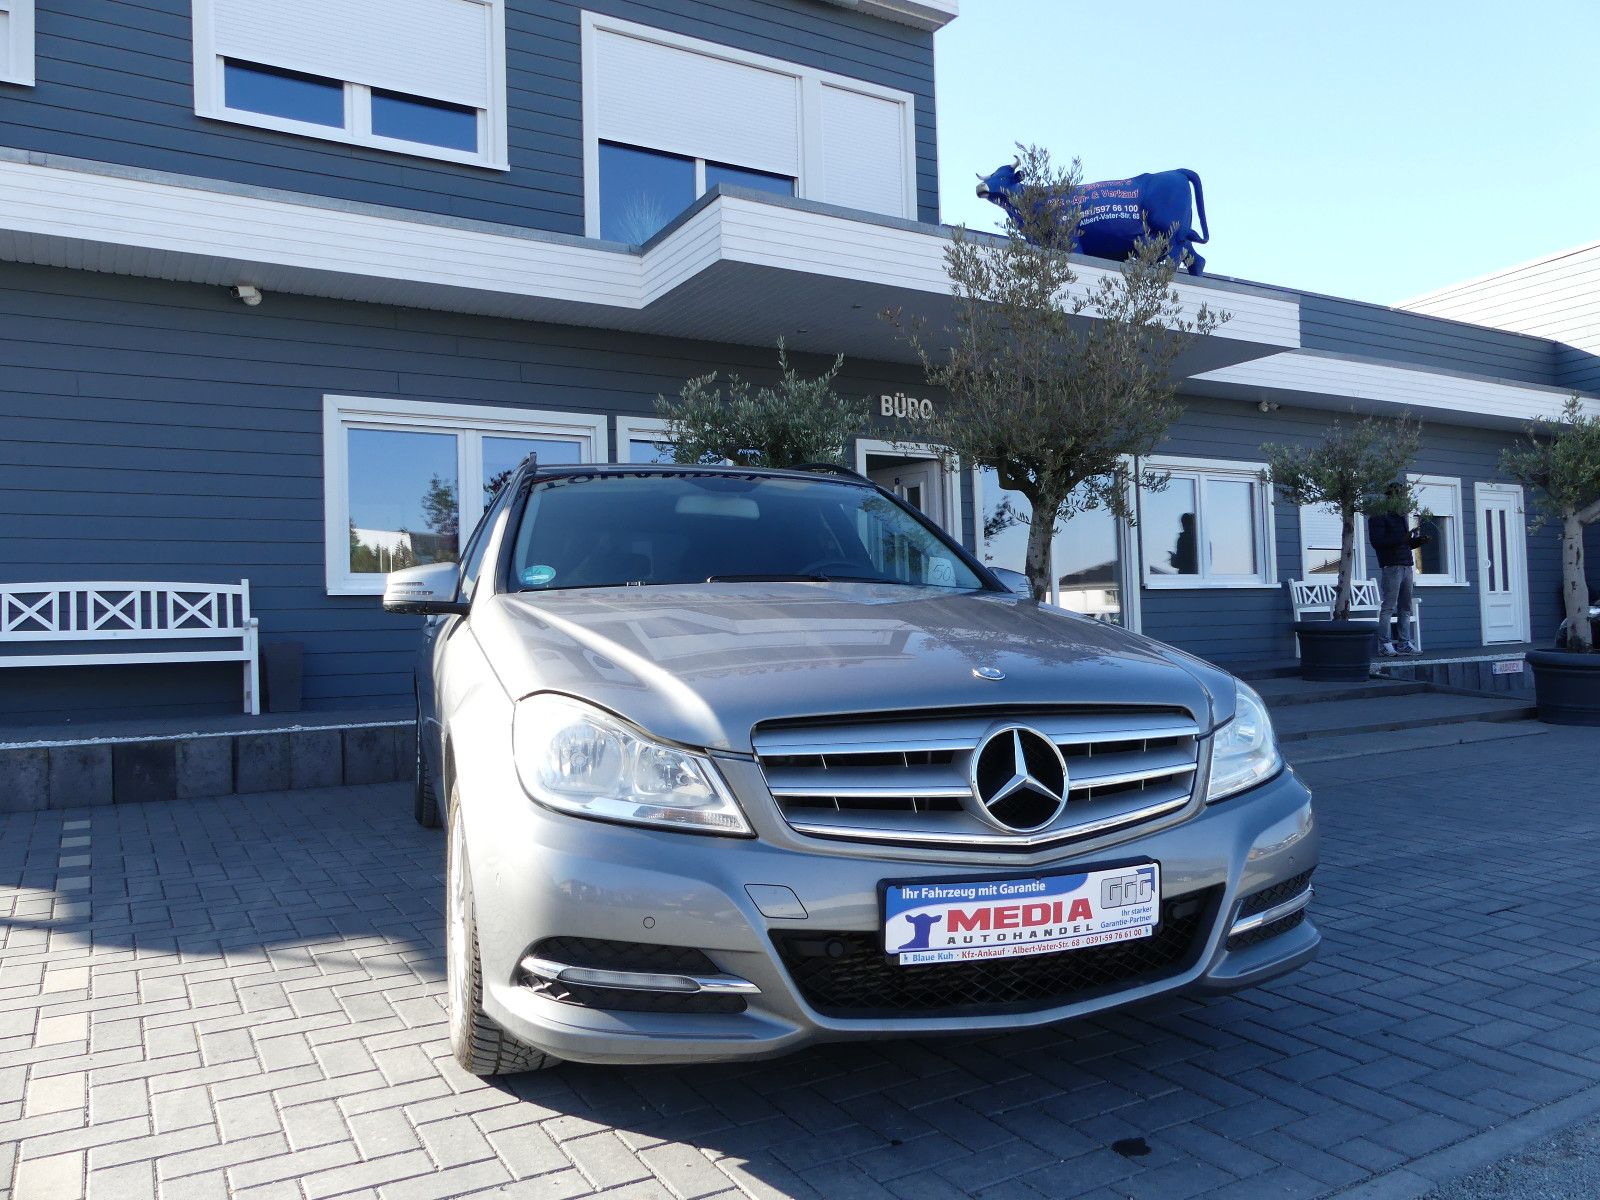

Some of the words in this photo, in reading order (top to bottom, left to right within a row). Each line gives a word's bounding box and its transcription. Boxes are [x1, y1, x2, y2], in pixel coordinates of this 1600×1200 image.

[1101, 189, 1139, 199] Verkauf
[1112, 204, 1122, 212] 66
[1124, 204, 1138, 212] 100
[880, 392, 933, 420] BÜRO
[902, 888, 919, 899] Ihr
[921, 887, 976, 899] Fahrzeug
[978, 885, 998, 896] mit
[999, 881, 1046, 894] Garantie
[947, 898, 1093, 933] MEDIA
[1121, 909, 1131, 917] Ihr
[1131, 906, 1153, 916] starker
[1100, 914, 1153, 929] Garantie-Partner
[947, 923, 1093, 945] AUTOHANDEL
[912, 953, 935, 962] Blaue
[937, 951, 954, 960] Kuh
[961, 947, 1006, 959] Kfz-Ankauf
[1012, 940, 1070, 954] Albert-Vater-Str.
[1072, 938, 1080, 947] 68
[1086, 933, 1113, 945] 0391-59
[1115, 931, 1123, 940] 76
[1124, 930, 1132, 939] 61
[1133, 928, 1142, 937] 00
